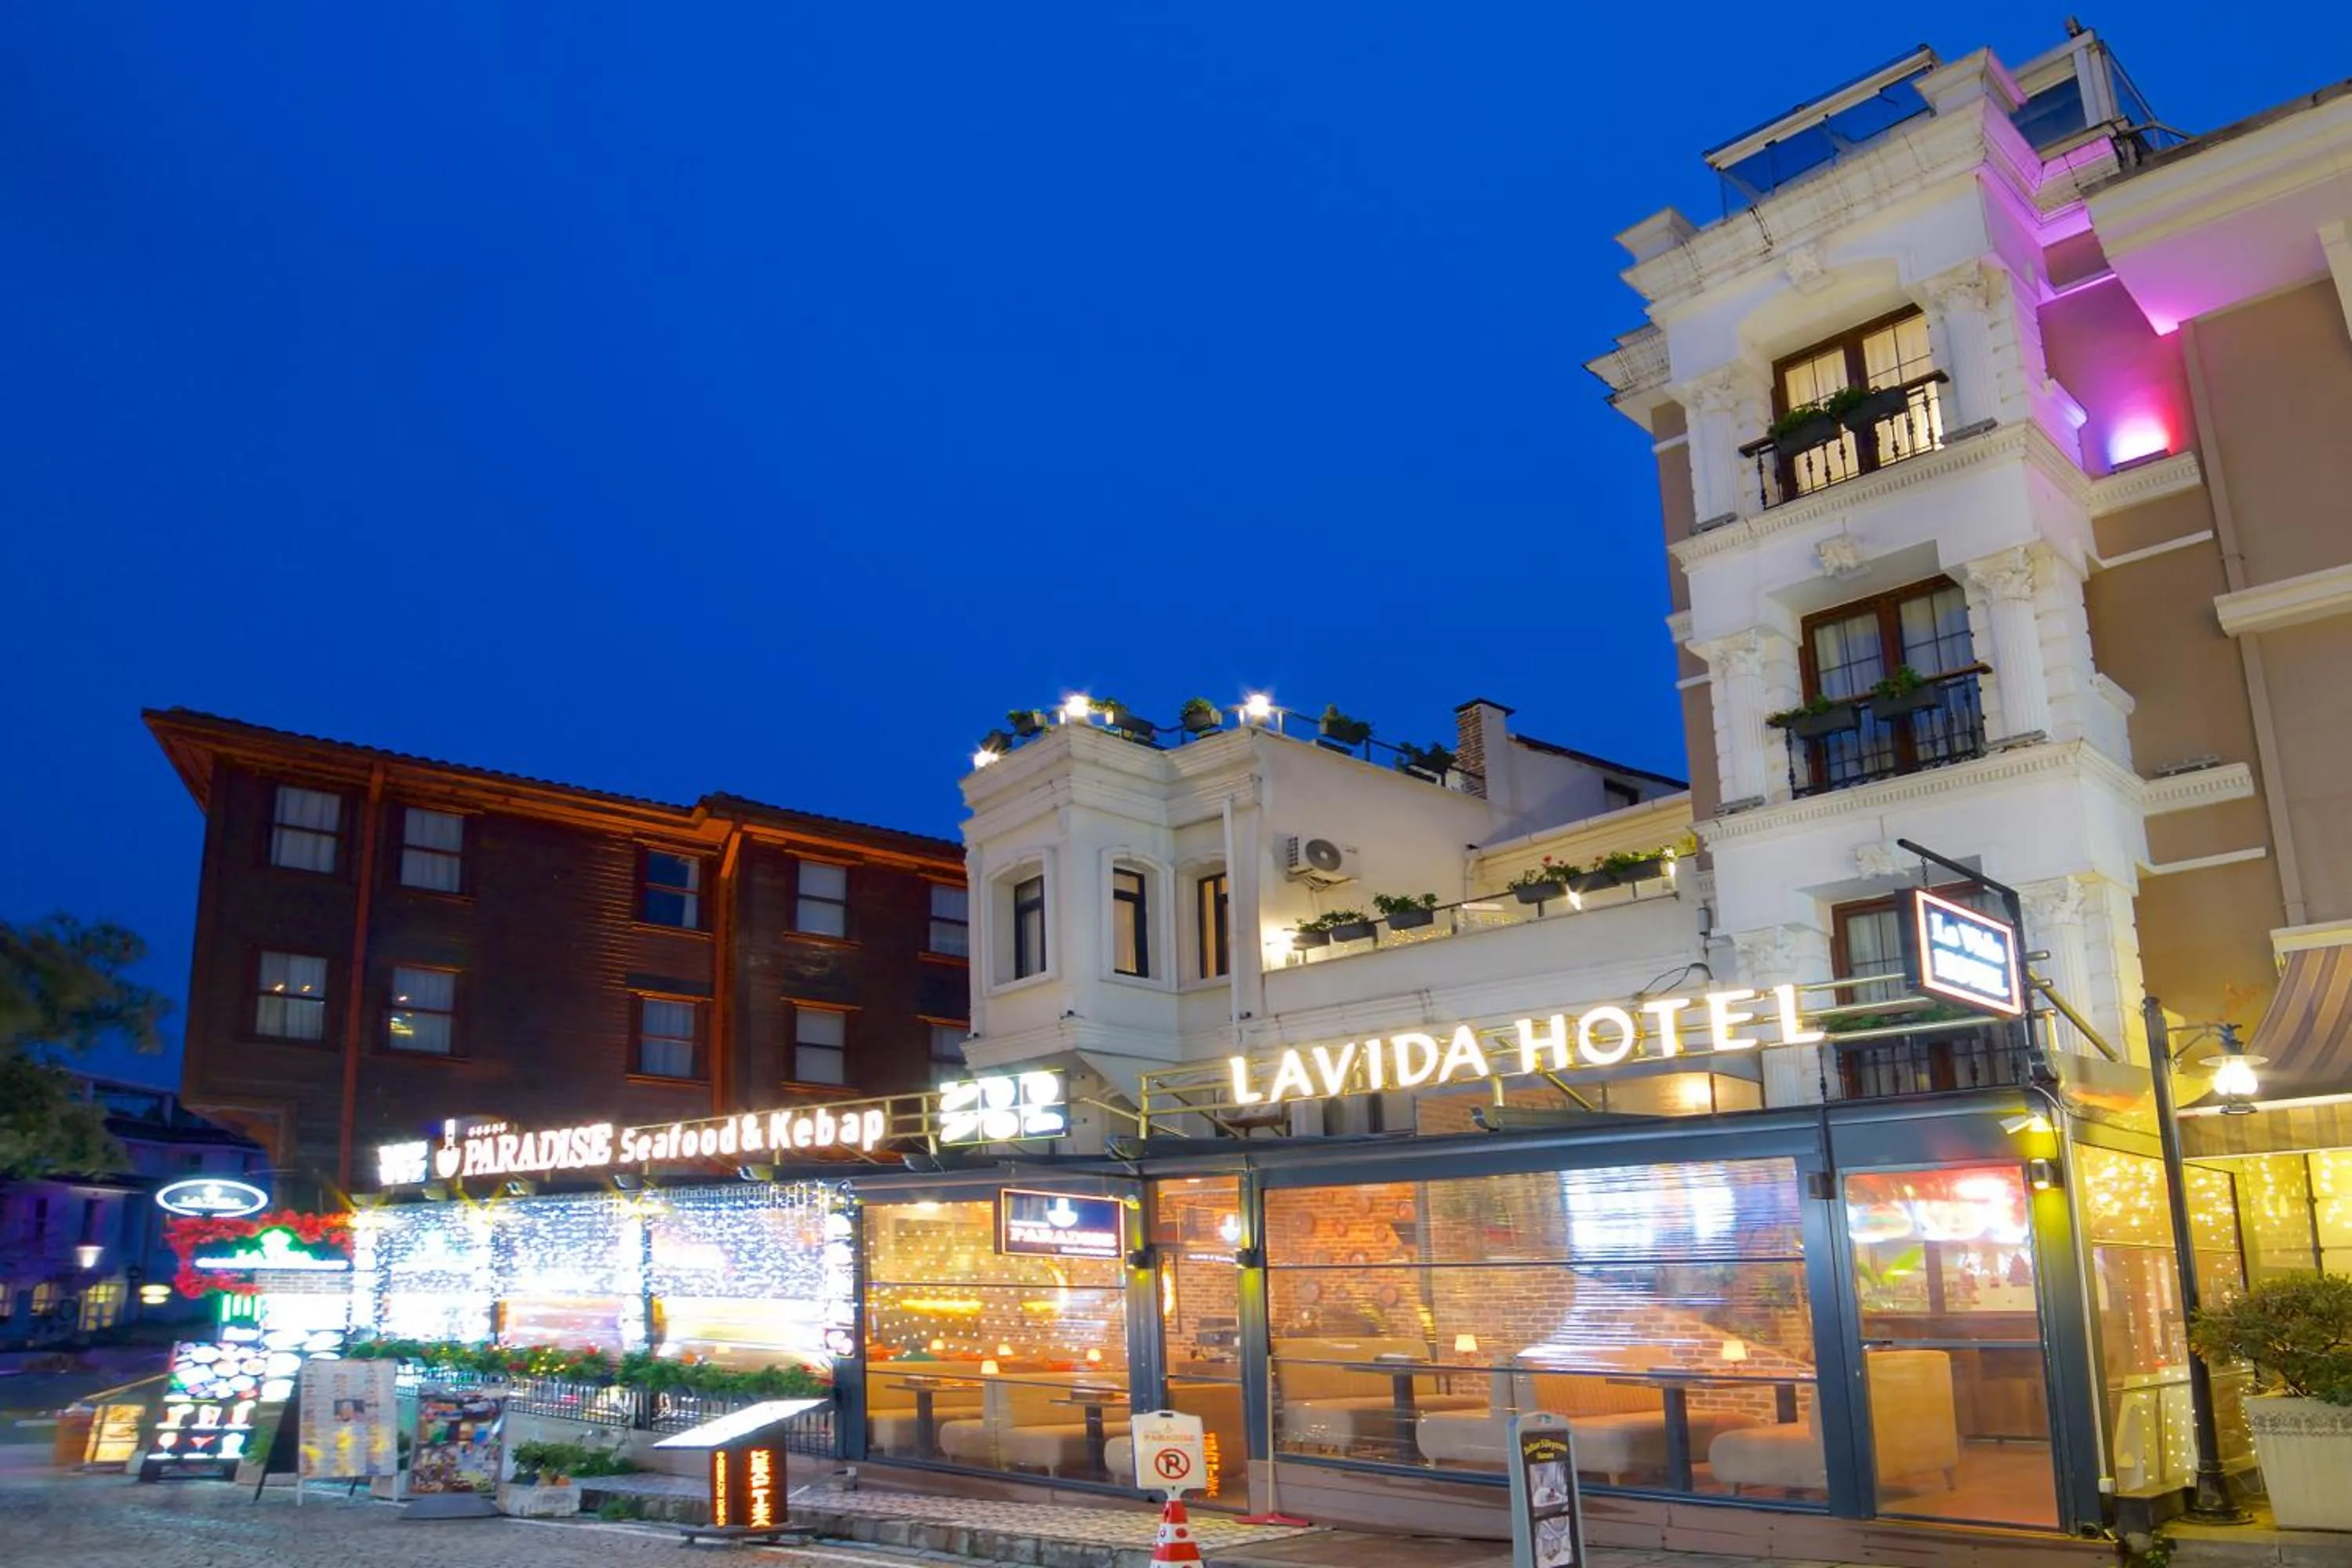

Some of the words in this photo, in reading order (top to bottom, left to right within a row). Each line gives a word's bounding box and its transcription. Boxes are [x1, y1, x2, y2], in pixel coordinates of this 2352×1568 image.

[1229, 1025, 1490, 1105] LAVIDA
[1515, 984, 1825, 1073] HOTEL
[463, 1123, 612, 1177] PARADISE
[619, 1116, 738, 1163] Seafood
[769, 1108, 884, 1152] Kebap
